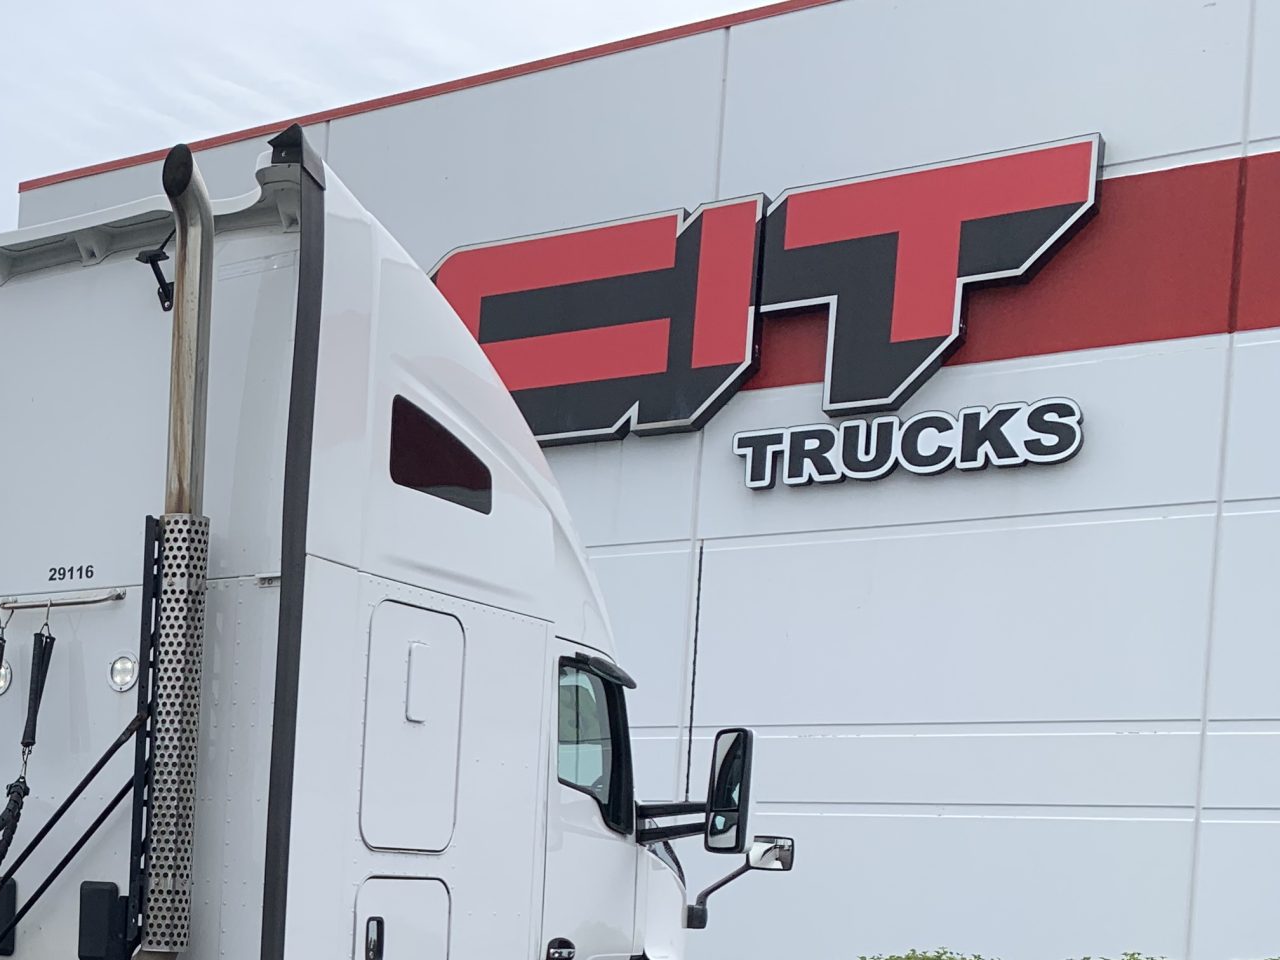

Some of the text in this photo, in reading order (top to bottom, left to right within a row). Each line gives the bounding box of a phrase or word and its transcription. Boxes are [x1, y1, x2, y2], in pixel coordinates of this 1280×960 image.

[429, 132, 1104, 446] CIT
[733, 396, 1084, 490] TRUCKS
[48, 564, 94, 581] 29116
